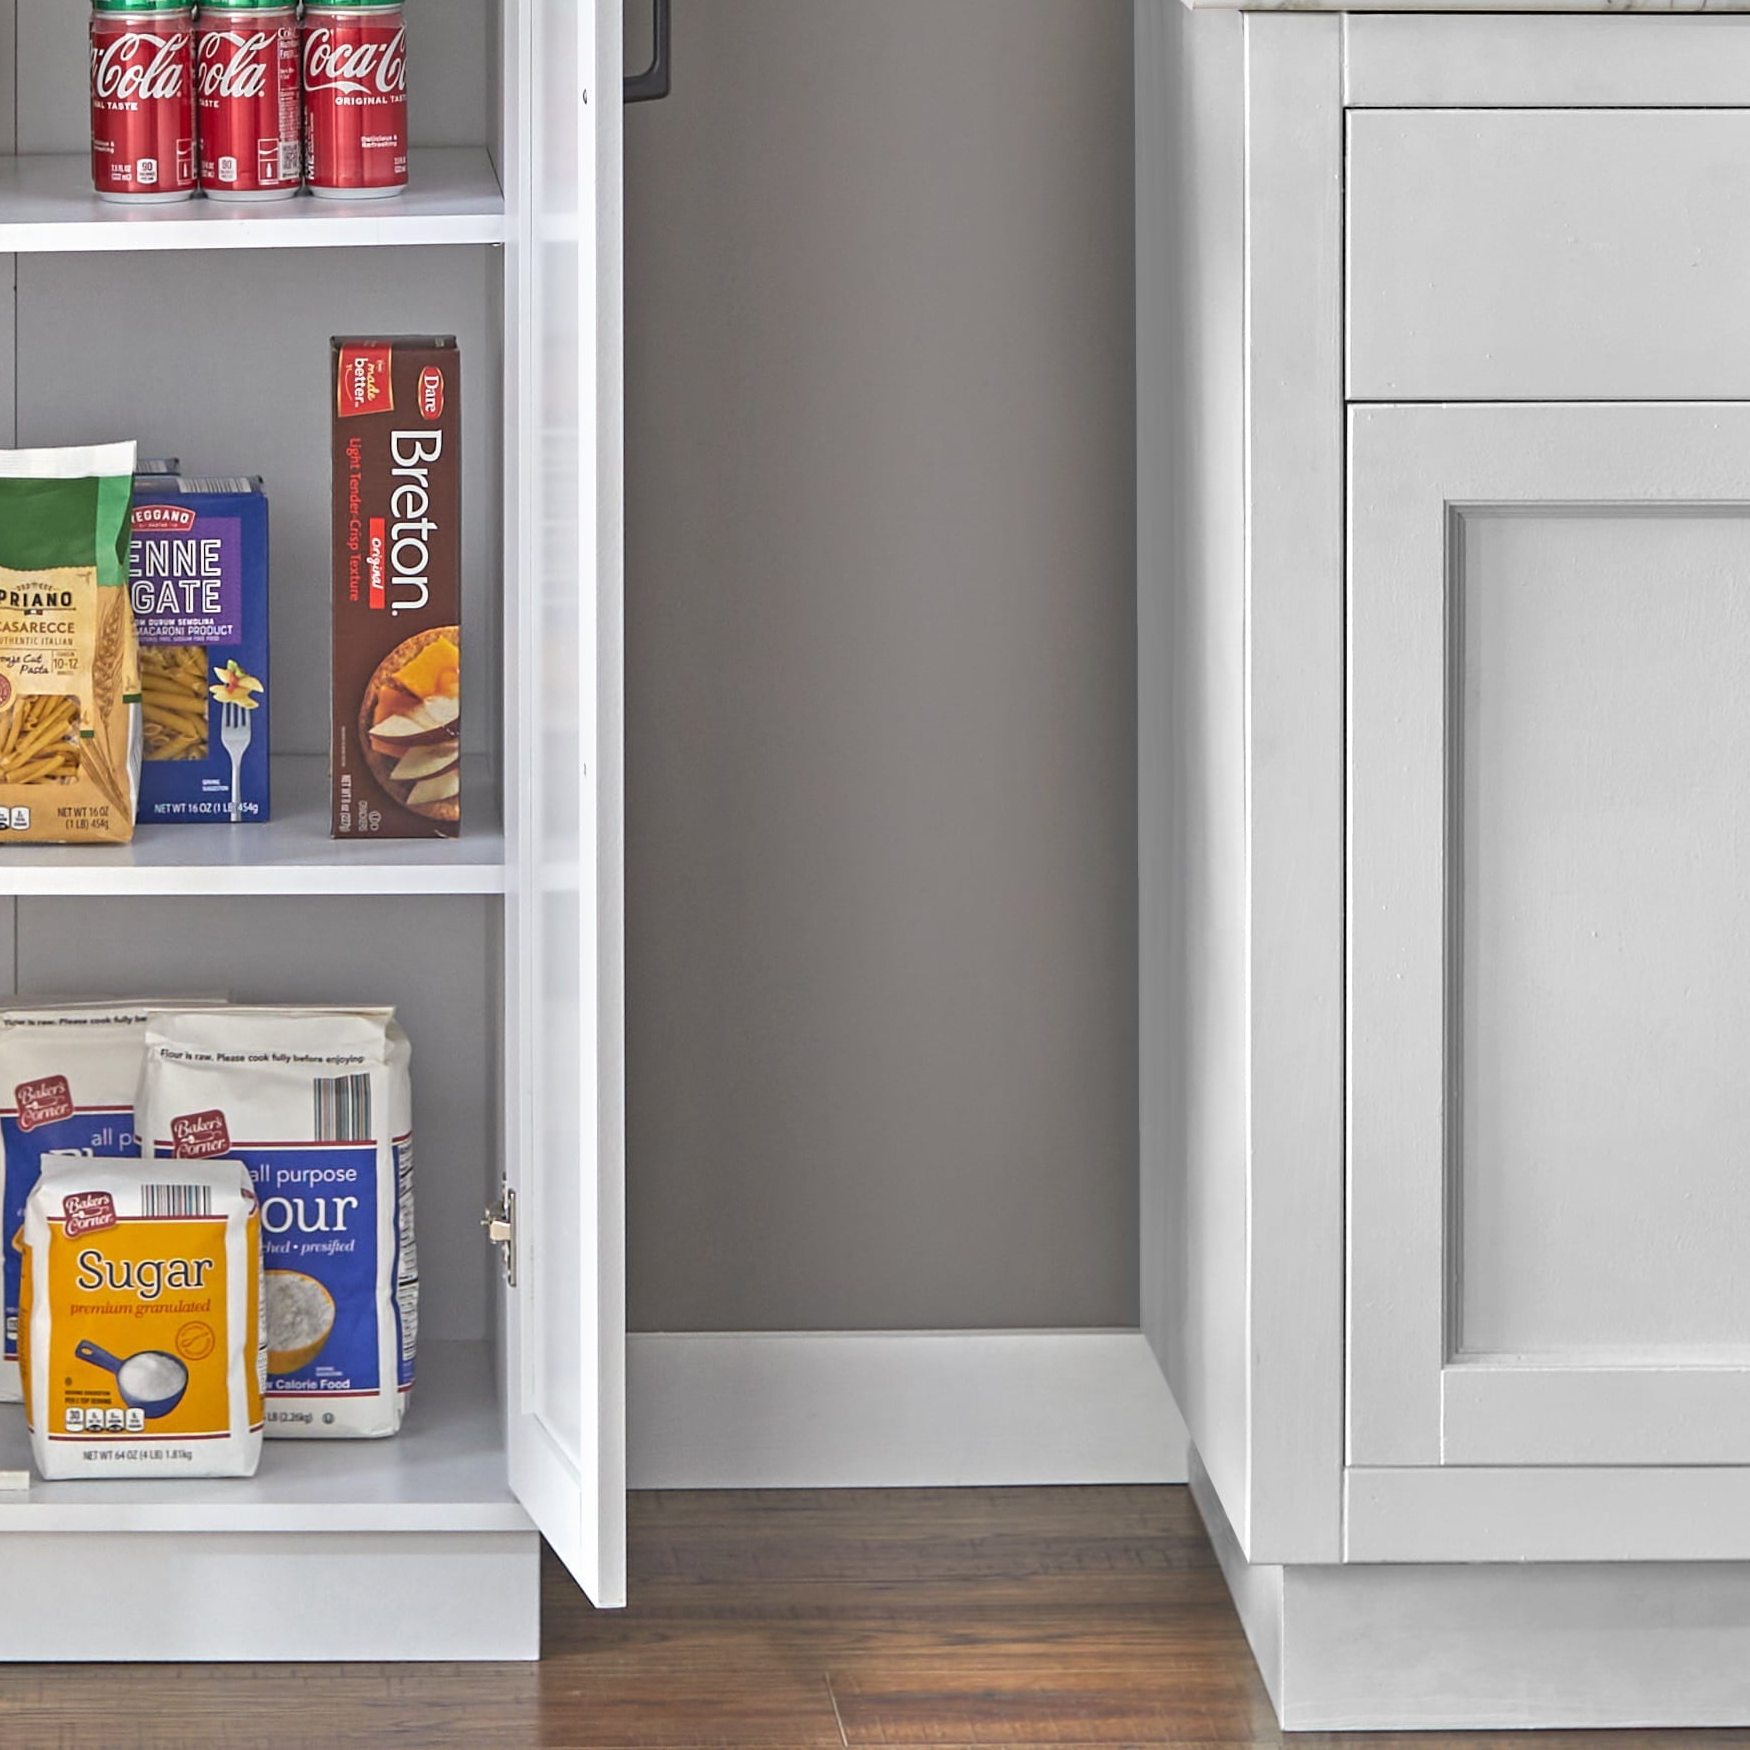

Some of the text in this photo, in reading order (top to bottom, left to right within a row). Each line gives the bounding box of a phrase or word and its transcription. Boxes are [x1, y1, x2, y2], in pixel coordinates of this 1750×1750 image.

[107, 101, 138, 111] TASTE
[335, 95, 388, 106] ORIGINAL
[354, 357, 369, 404] better
[367, 362, 380, 401] made
[423, 375, 440, 414] Dare
[346, 438, 362, 602] Light Tender-Crisp Texture
[391, 429, 443, 610] Breton
[366, 536, 383, 592] original
[131, 579, 222, 614] GATE
[148, 618, 215, 626] DURUM SEMOLINA
[187, 625, 233, 636] PRODUCT
[41, 637, 73, 646] ITALIAN
[23, 653, 43, 664] Cut
[53, 657, 79, 669] 10-12
[19, 664, 49, 675] Pasta
[57, 806, 109, 817] NET WT 16 OZ
[153, 803, 171, 813] NET
[172, 803, 186, 813] WT
[188, 803, 198, 813] 16
[199, 803, 211, 813] OZ
[75, 818, 109, 831] LB) 454g
[59, 1017, 88, 1025] Please
[113, 1016, 133, 1025] fully
[160, 1049, 365, 1066] Flour is raw. Please cook fully before enjoying
[18, 1081, 67, 1106] Baker's
[20, 1103, 70, 1129] Corner
[90, 1127, 113, 1147] all
[173, 1116, 223, 1139] Baker's
[176, 1138, 226, 1159] Corner
[250, 1163, 358, 1188] all purpose
[65, 1194, 110, 1214] Baker's
[66, 1213, 113, 1235] Corner
[261, 1196, 359, 1233] our
[300, 1239, 356, 1256] presifted
[77, 1249, 214, 1300] Sugar
[70, 1299, 211, 1319] premium granulated
[275, 1378, 351, 1390] Calorie Food
[83, 1449, 163, 1461] NET WT 64 OZ LB)
